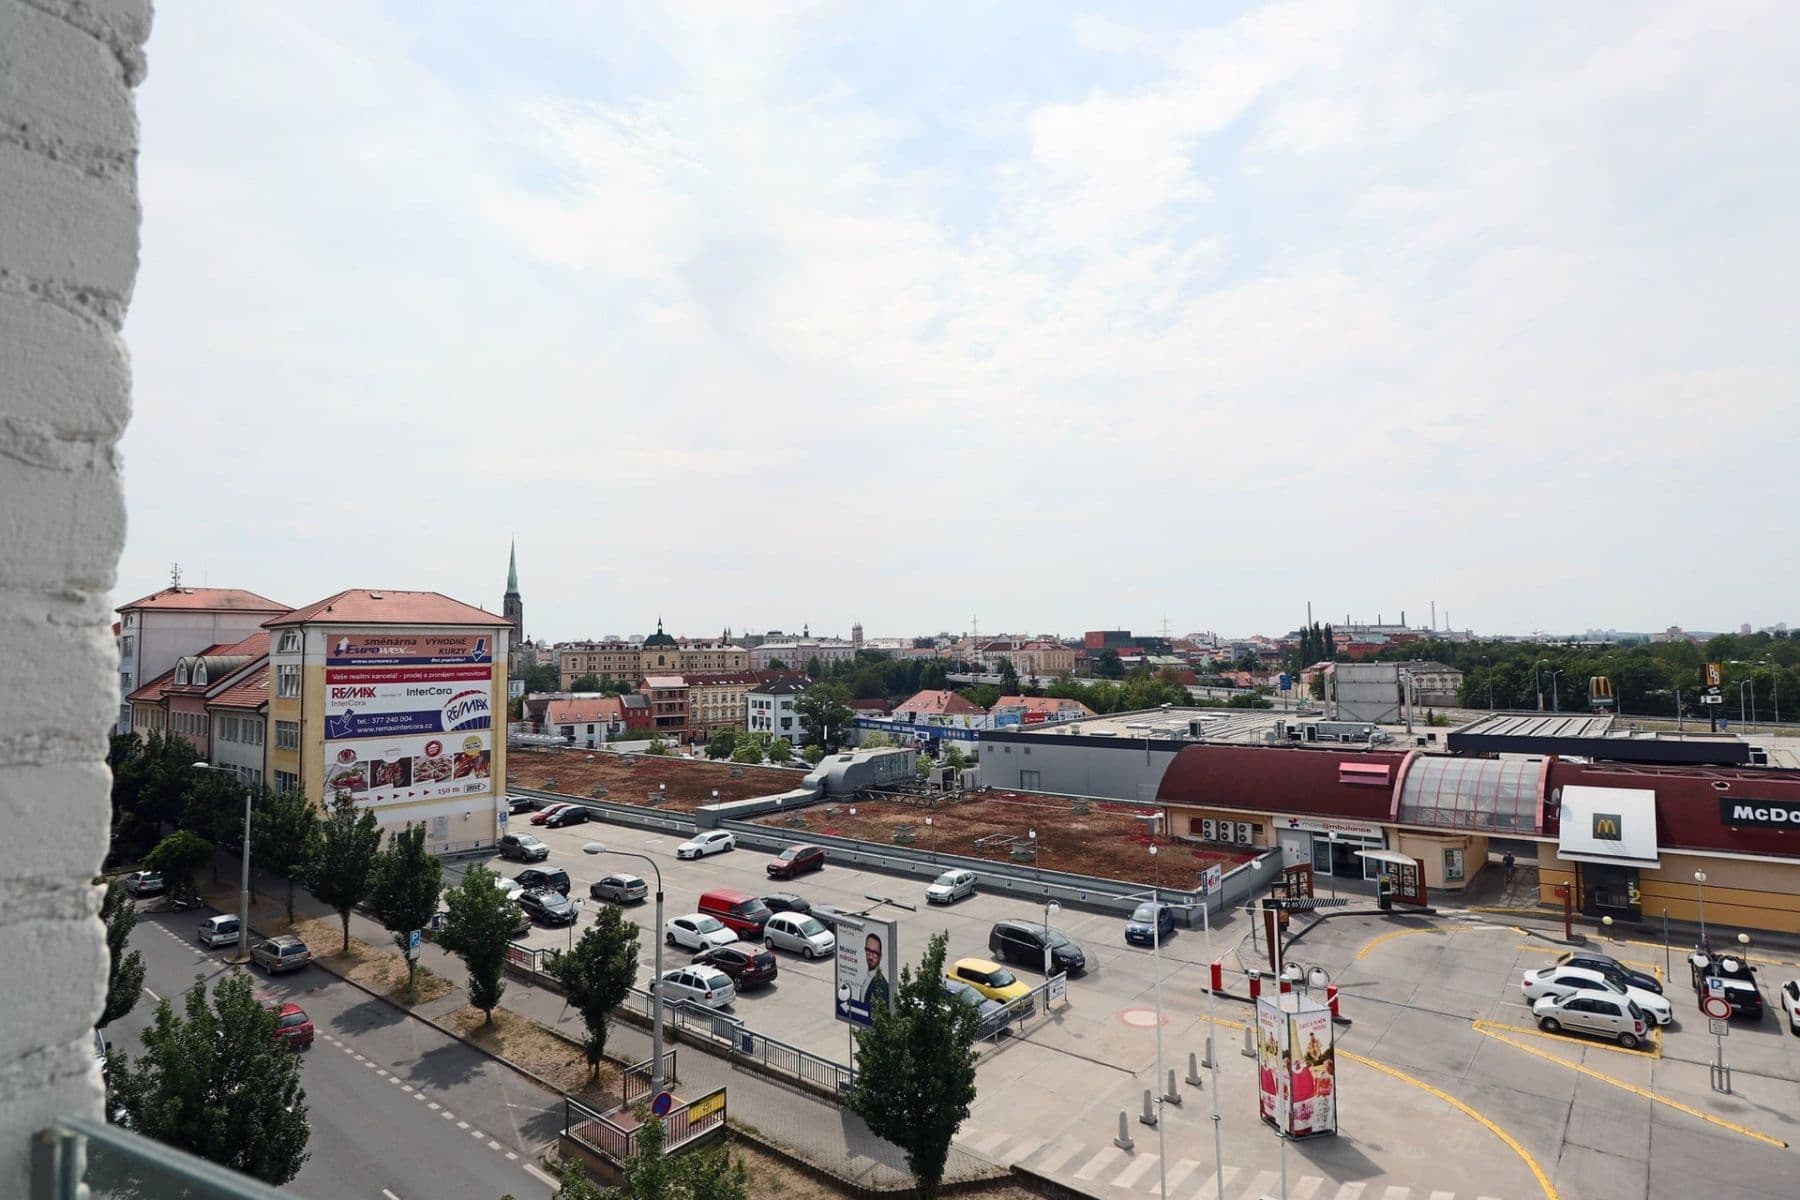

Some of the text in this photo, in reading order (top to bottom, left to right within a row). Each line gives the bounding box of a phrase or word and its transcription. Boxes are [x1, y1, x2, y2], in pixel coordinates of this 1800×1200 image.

[363, 637, 417, 646] směnárna
[425, 636, 467, 645] VÝHODNÉ
[345, 645, 407, 654] Eurowex
[371, 672, 398, 680] kancelář
[403, 672, 423, 680] prodej
[428, 671, 455, 679] pronájem
[332, 686, 377, 699] RE/MAX
[406, 687, 453, 697] InterCora
[446, 698, 489, 723] RE/MAX
[356, 722, 433, 733] www.remaxintercora.cz
[438, 787, 451, 795] 150
